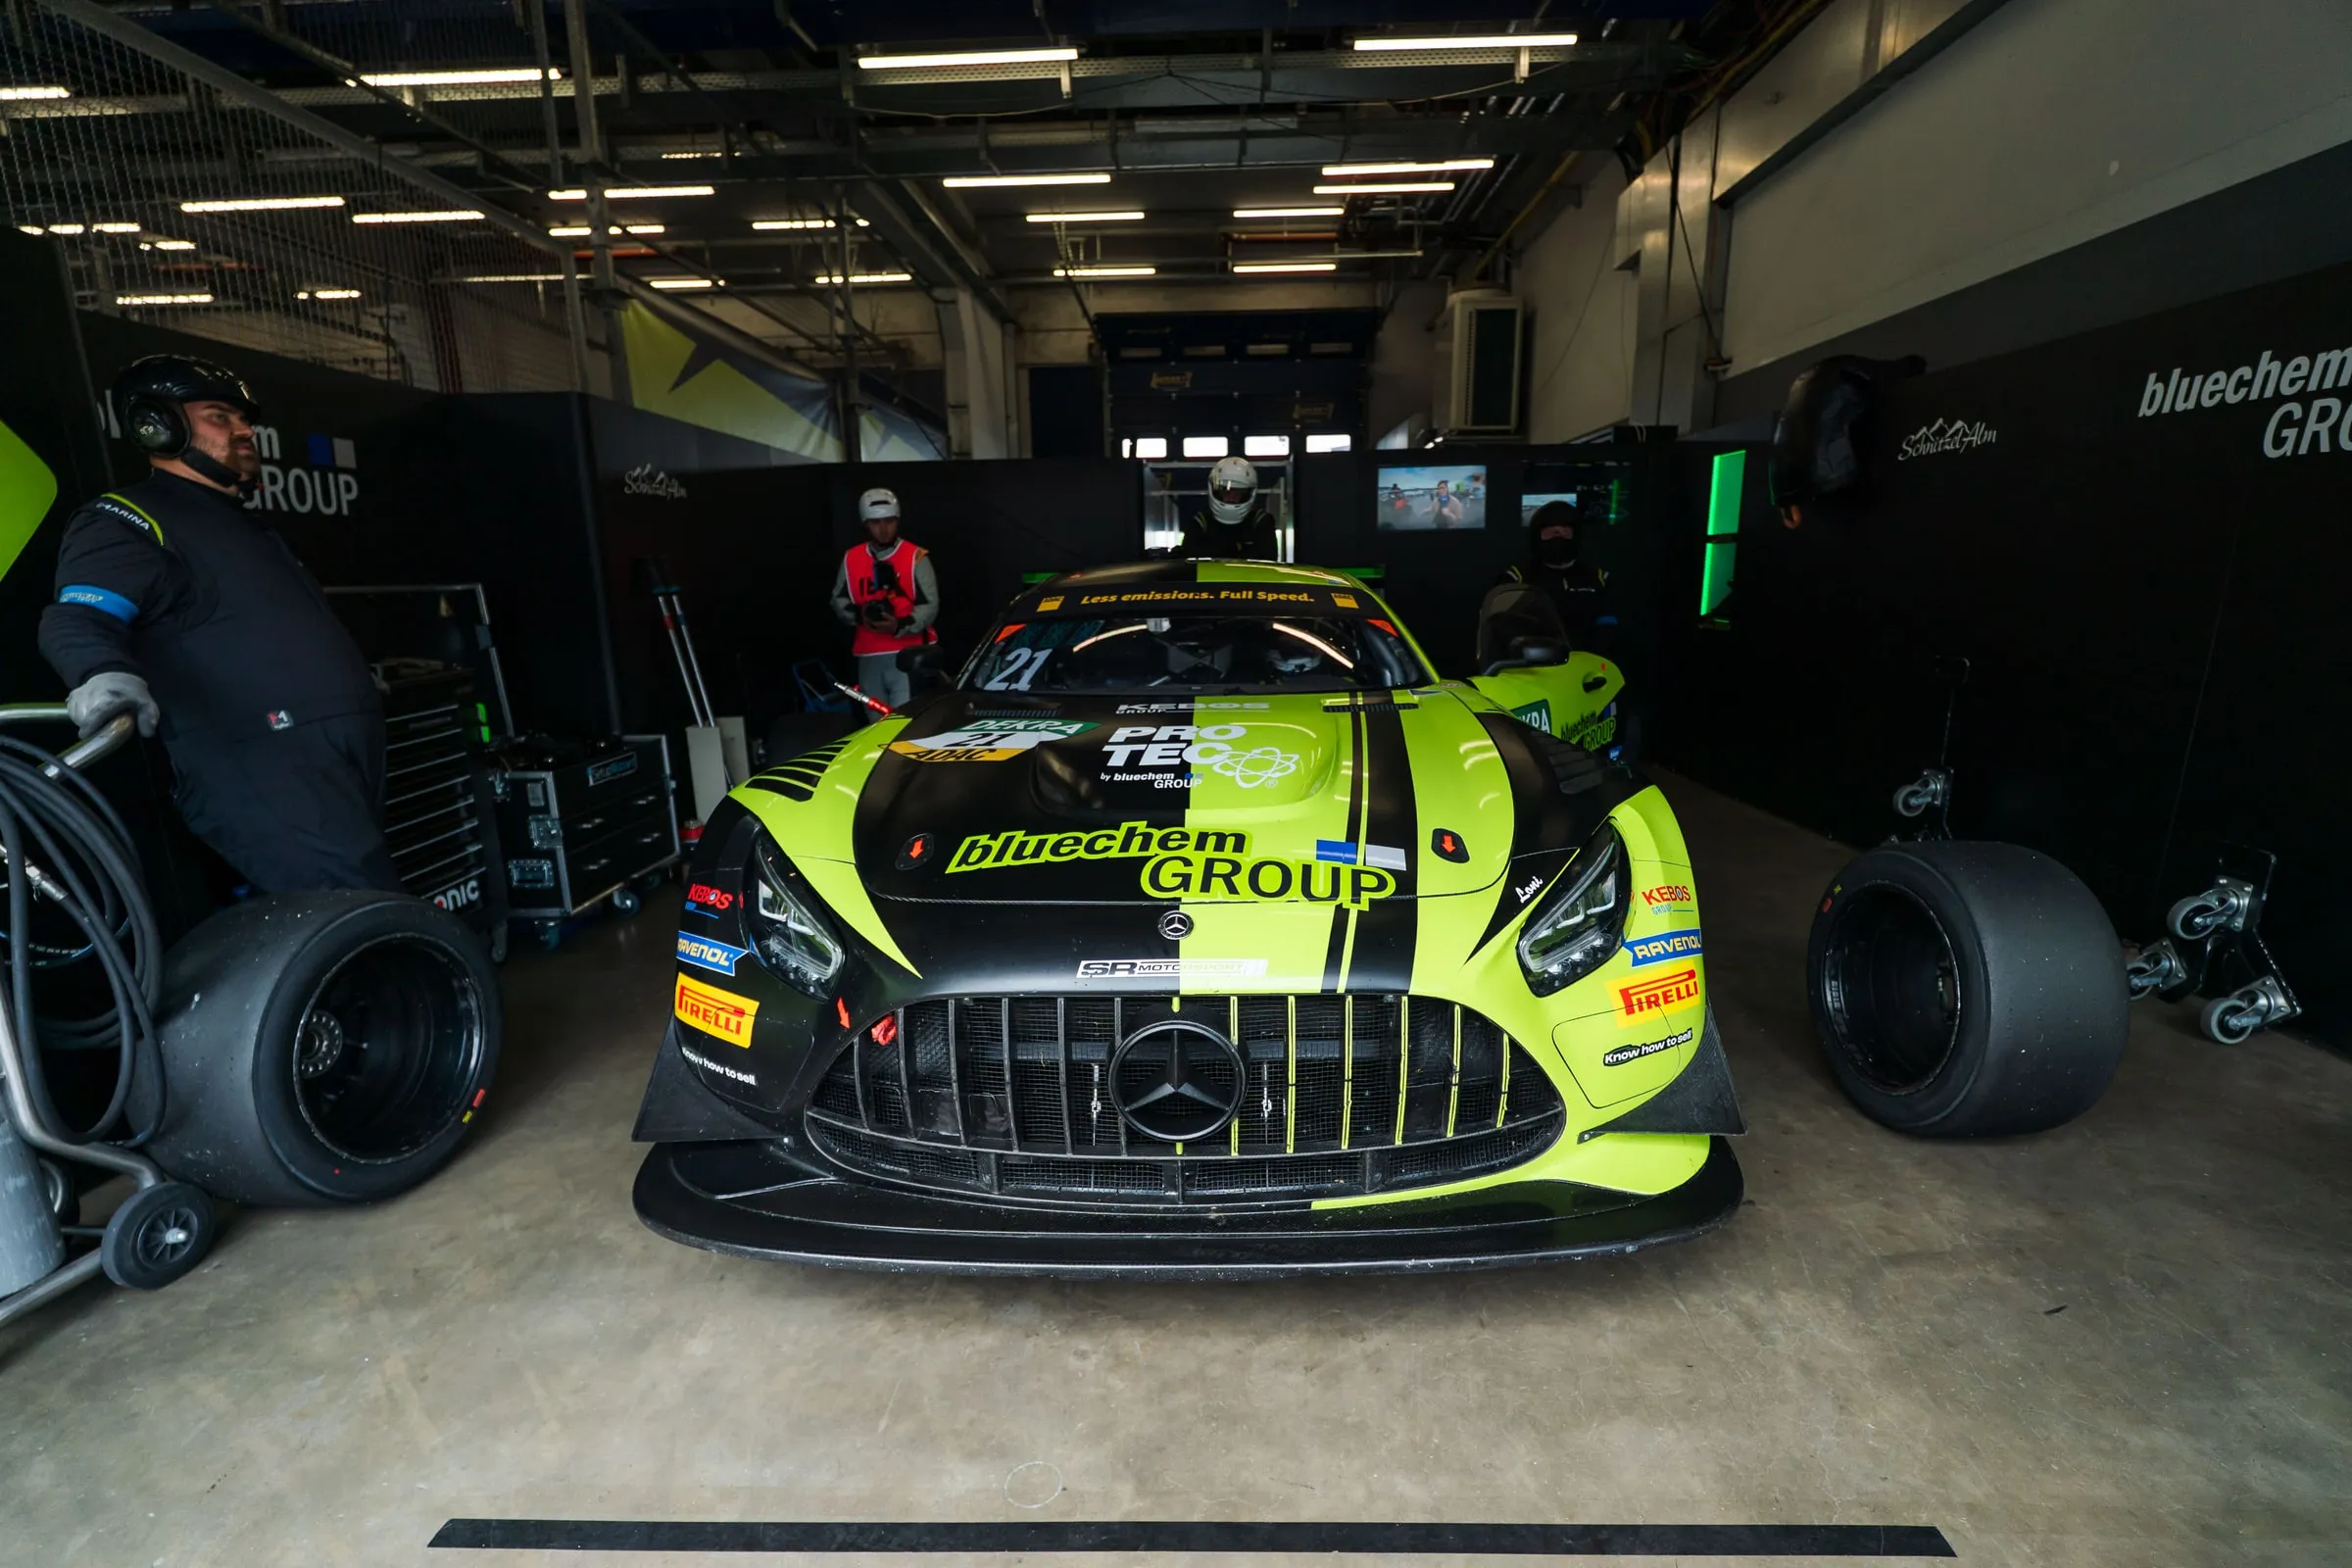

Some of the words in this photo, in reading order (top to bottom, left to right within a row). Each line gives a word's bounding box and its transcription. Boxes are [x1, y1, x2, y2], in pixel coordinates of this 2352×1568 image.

[2137, 346, 2352, 417] bluechem
[1080, 595, 1118, 605] Less
[1219, 590, 1253, 600] Full
[1256, 591, 1315, 603] Speed.
[983, 647, 1054, 691] 21
[960, 720, 1084, 735] DEKRA
[1519, 708, 1551, 734] KRA
[943, 732, 1017, 747] 21
[1107, 725, 1247, 743] PRO
[904, 748, 998, 761] ADAC
[1102, 742, 1234, 766] TEC
[1101, 771, 1111, 782] by
[1113, 771, 1175, 781] bluechem
[1154, 779, 1202, 789] GROUP
[955, 826, 1248, 868] bluechem
[1147, 858, 1391, 904] GROUP
[1642, 885, 1691, 906] KEBOS
[1081, 961, 1138, 976] SR
[1619, 968, 1698, 1016] PIRELLI
[677, 984, 745, 1035] PIRELLI
[1603, 1046, 1641, 1064] Know
[1642, 1040, 1665, 1055] how
[1666, 1035, 1678, 1048] to
[703, 1057, 725, 1075] how
[724, 1066, 737, 1079] to
